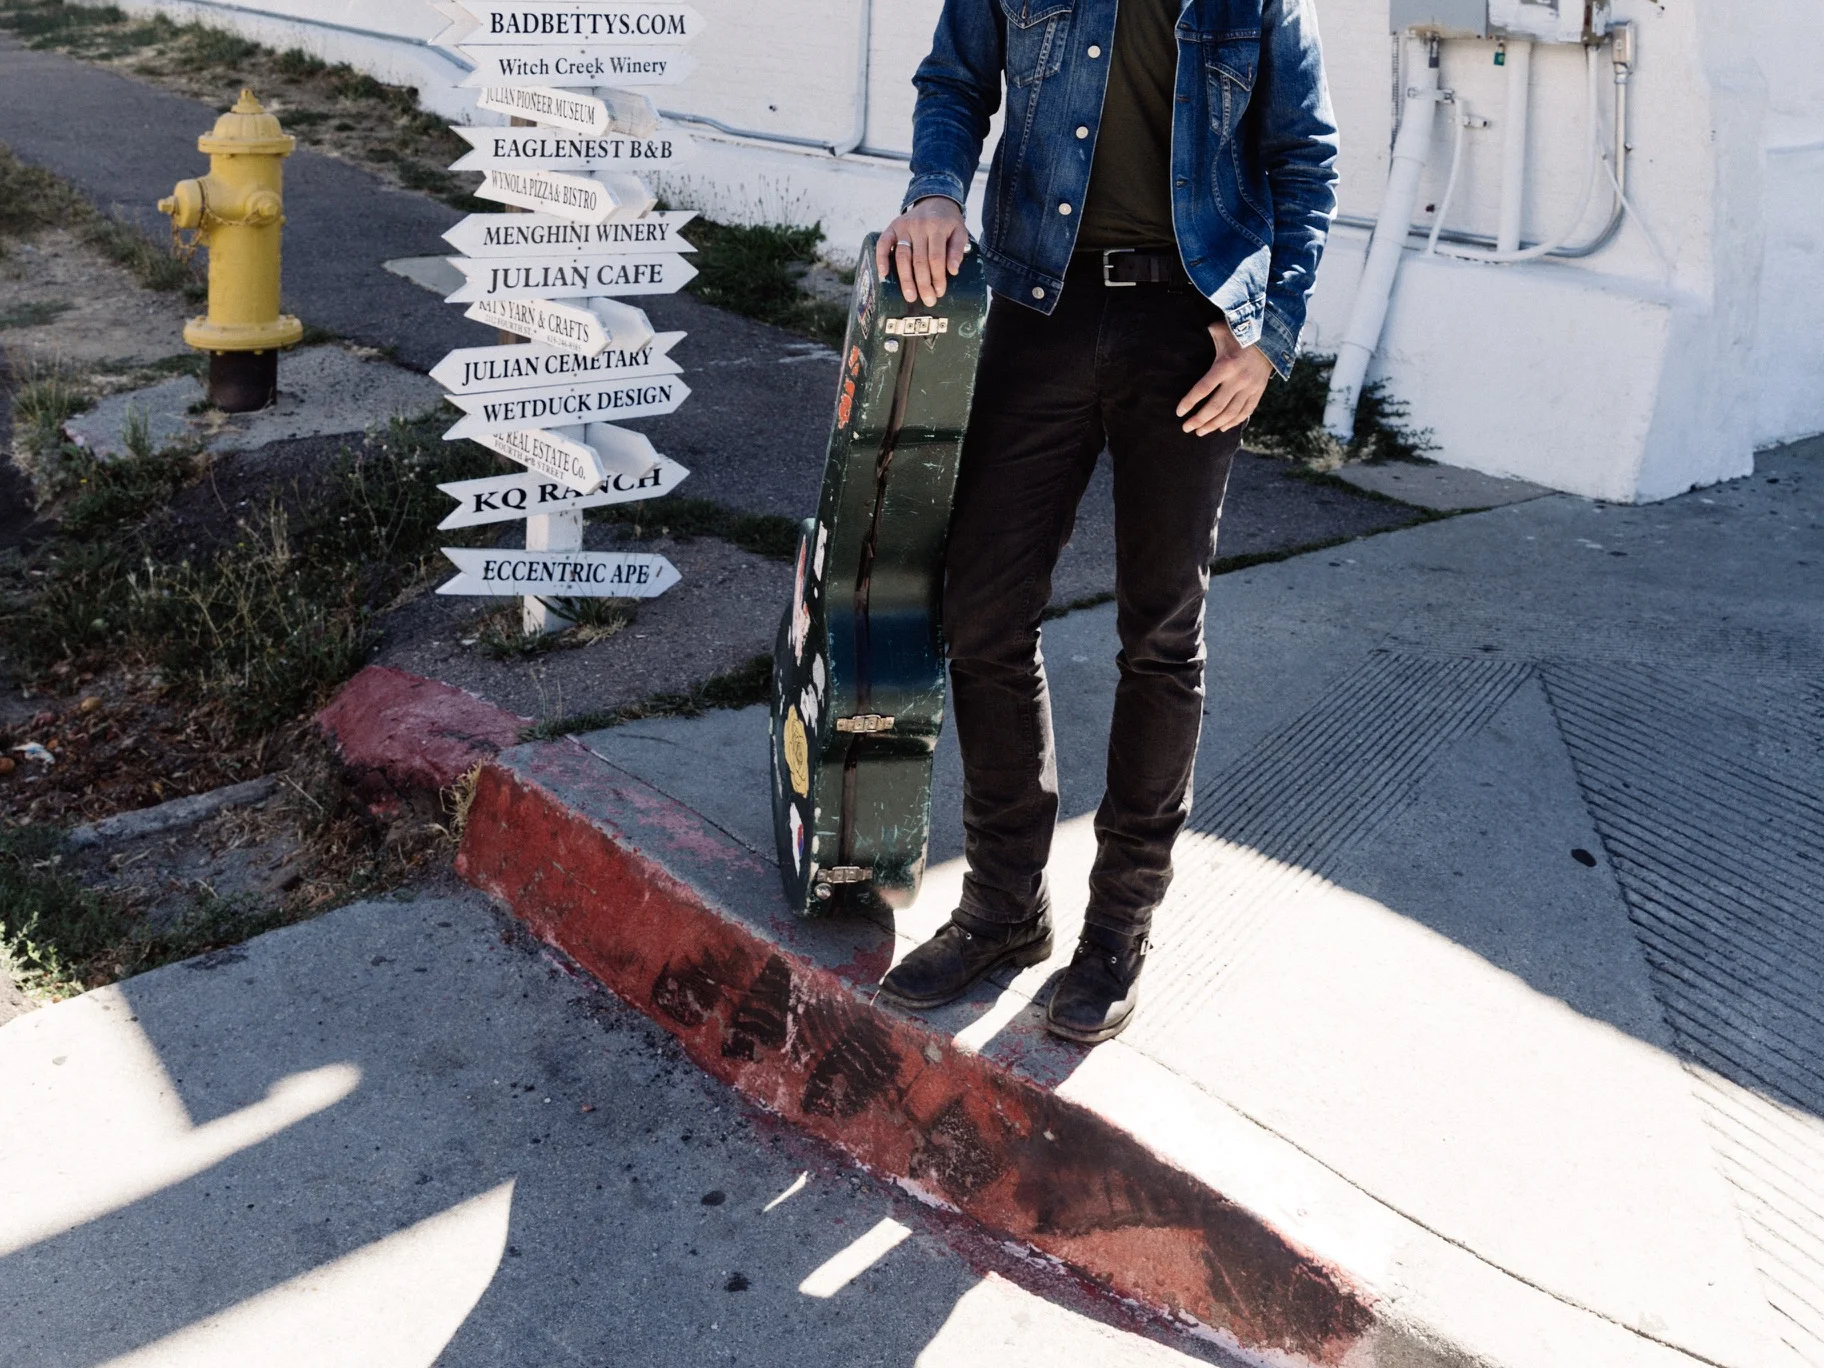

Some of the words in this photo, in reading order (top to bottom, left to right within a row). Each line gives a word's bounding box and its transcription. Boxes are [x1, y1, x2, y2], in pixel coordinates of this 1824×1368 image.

[490, 12, 686, 35] BADBETTYS.COM
[499, 58, 549, 76] Witch
[555, 57, 605, 75] Creek
[610, 57, 667, 76] Winery
[486, 87, 516, 105] JULIAN
[516, 90, 553, 114] PIONEER
[554, 98, 595, 125] MUSEUM
[493, 139, 624, 158] EAGLENEST
[630, 140, 673, 159] B&B
[492, 170, 528, 195] WYNOLA
[563, 186, 597, 211] BISTRO
[483, 224, 590, 246] MENGHINI
[596, 222, 670, 243] WINERY
[487, 266, 590, 294] JULIAN
[597, 264, 664, 285] CAFE
[508, 301, 536, 327] YARN
[538, 311, 546, 329] &
[548, 313, 589, 343] CRAFTS
[462, 356, 539, 386] JULIAN
[545, 347, 653, 375] CEMETARY
[483, 393, 592, 423] WETDUCK
[597, 385, 673, 410] DESIGN
[507, 430, 530, 454] REAL
[533, 443, 570, 472] ESTATE
[571, 457, 586, 479] Co.
[537, 462, 564, 480] STREET
[473, 487, 527, 513] KQ
[483, 560, 607, 584] ECCENTRIC
[611, 564, 650, 584] APE
